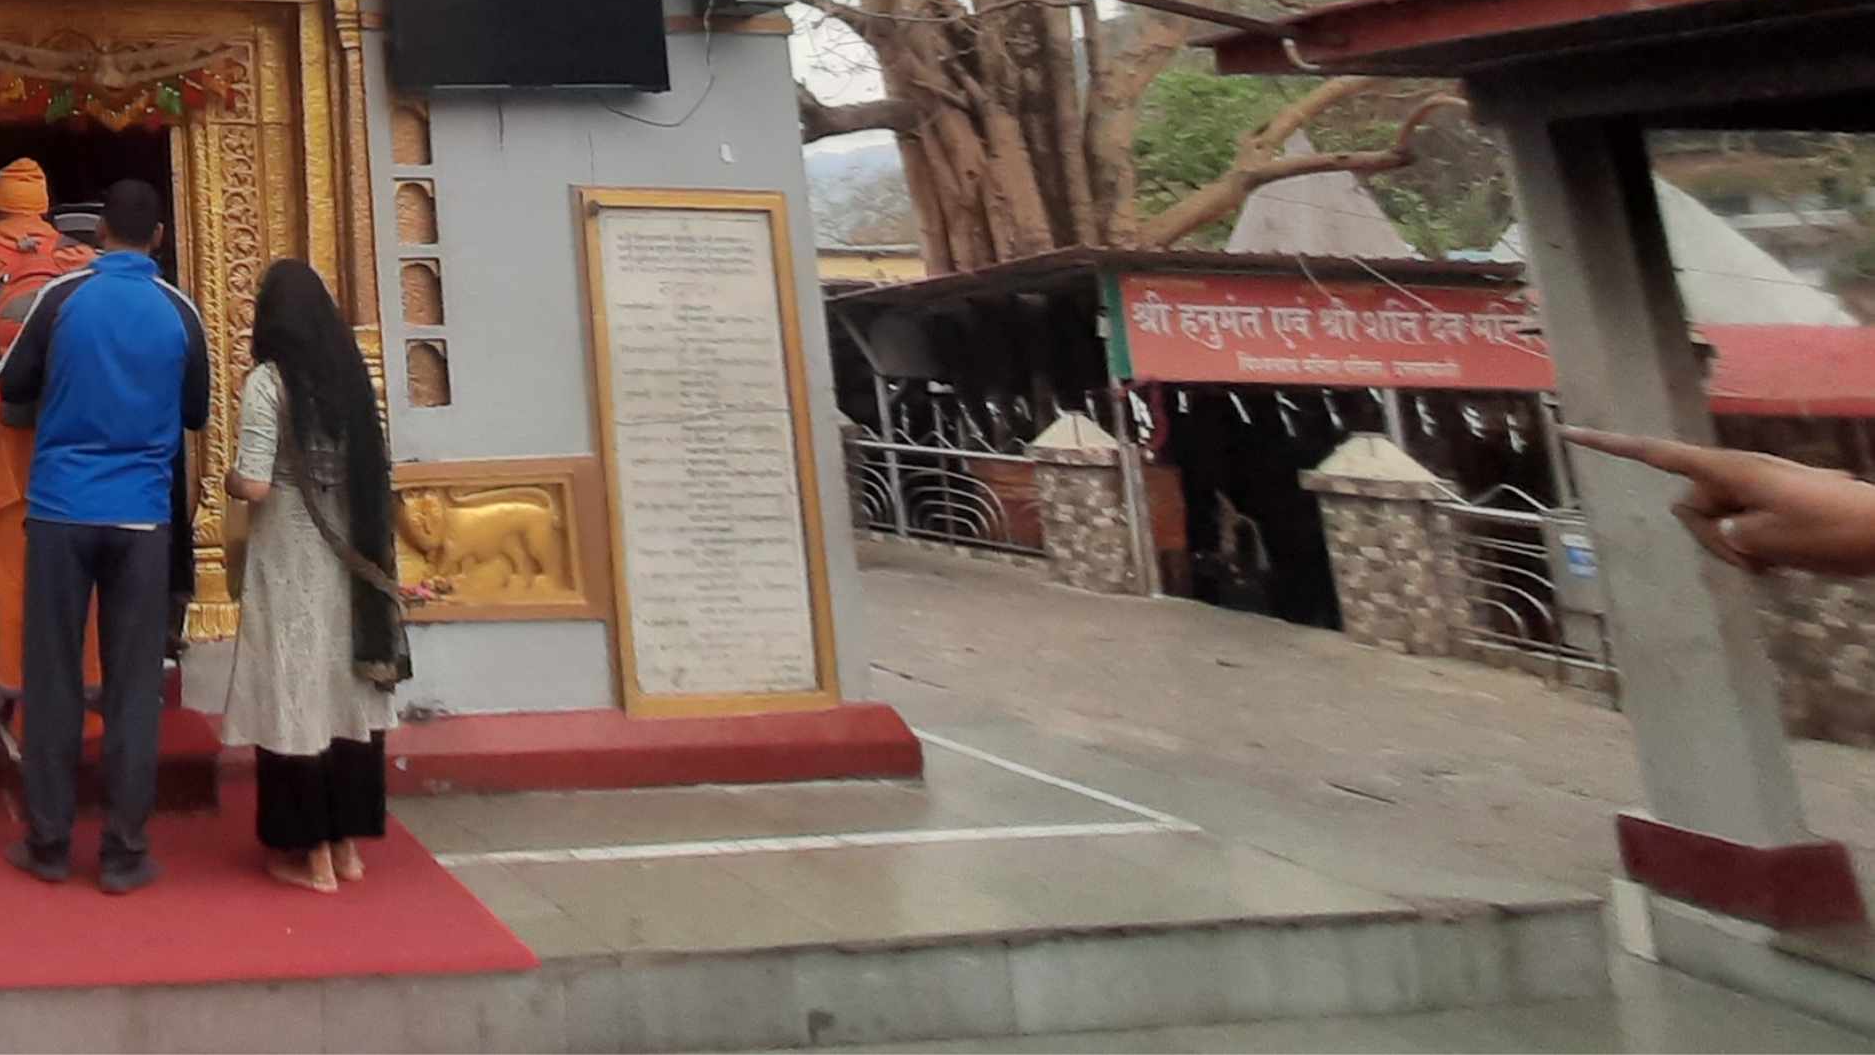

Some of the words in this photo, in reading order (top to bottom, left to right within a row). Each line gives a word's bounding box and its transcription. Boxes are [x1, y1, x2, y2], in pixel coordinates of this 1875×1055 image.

[1132, 289, 1173, 337] श्री
[1177, 294, 1264, 349] हनुमंत
[1319, 297, 1361, 343] श्री
[1361, 298, 1426, 345] शनि
